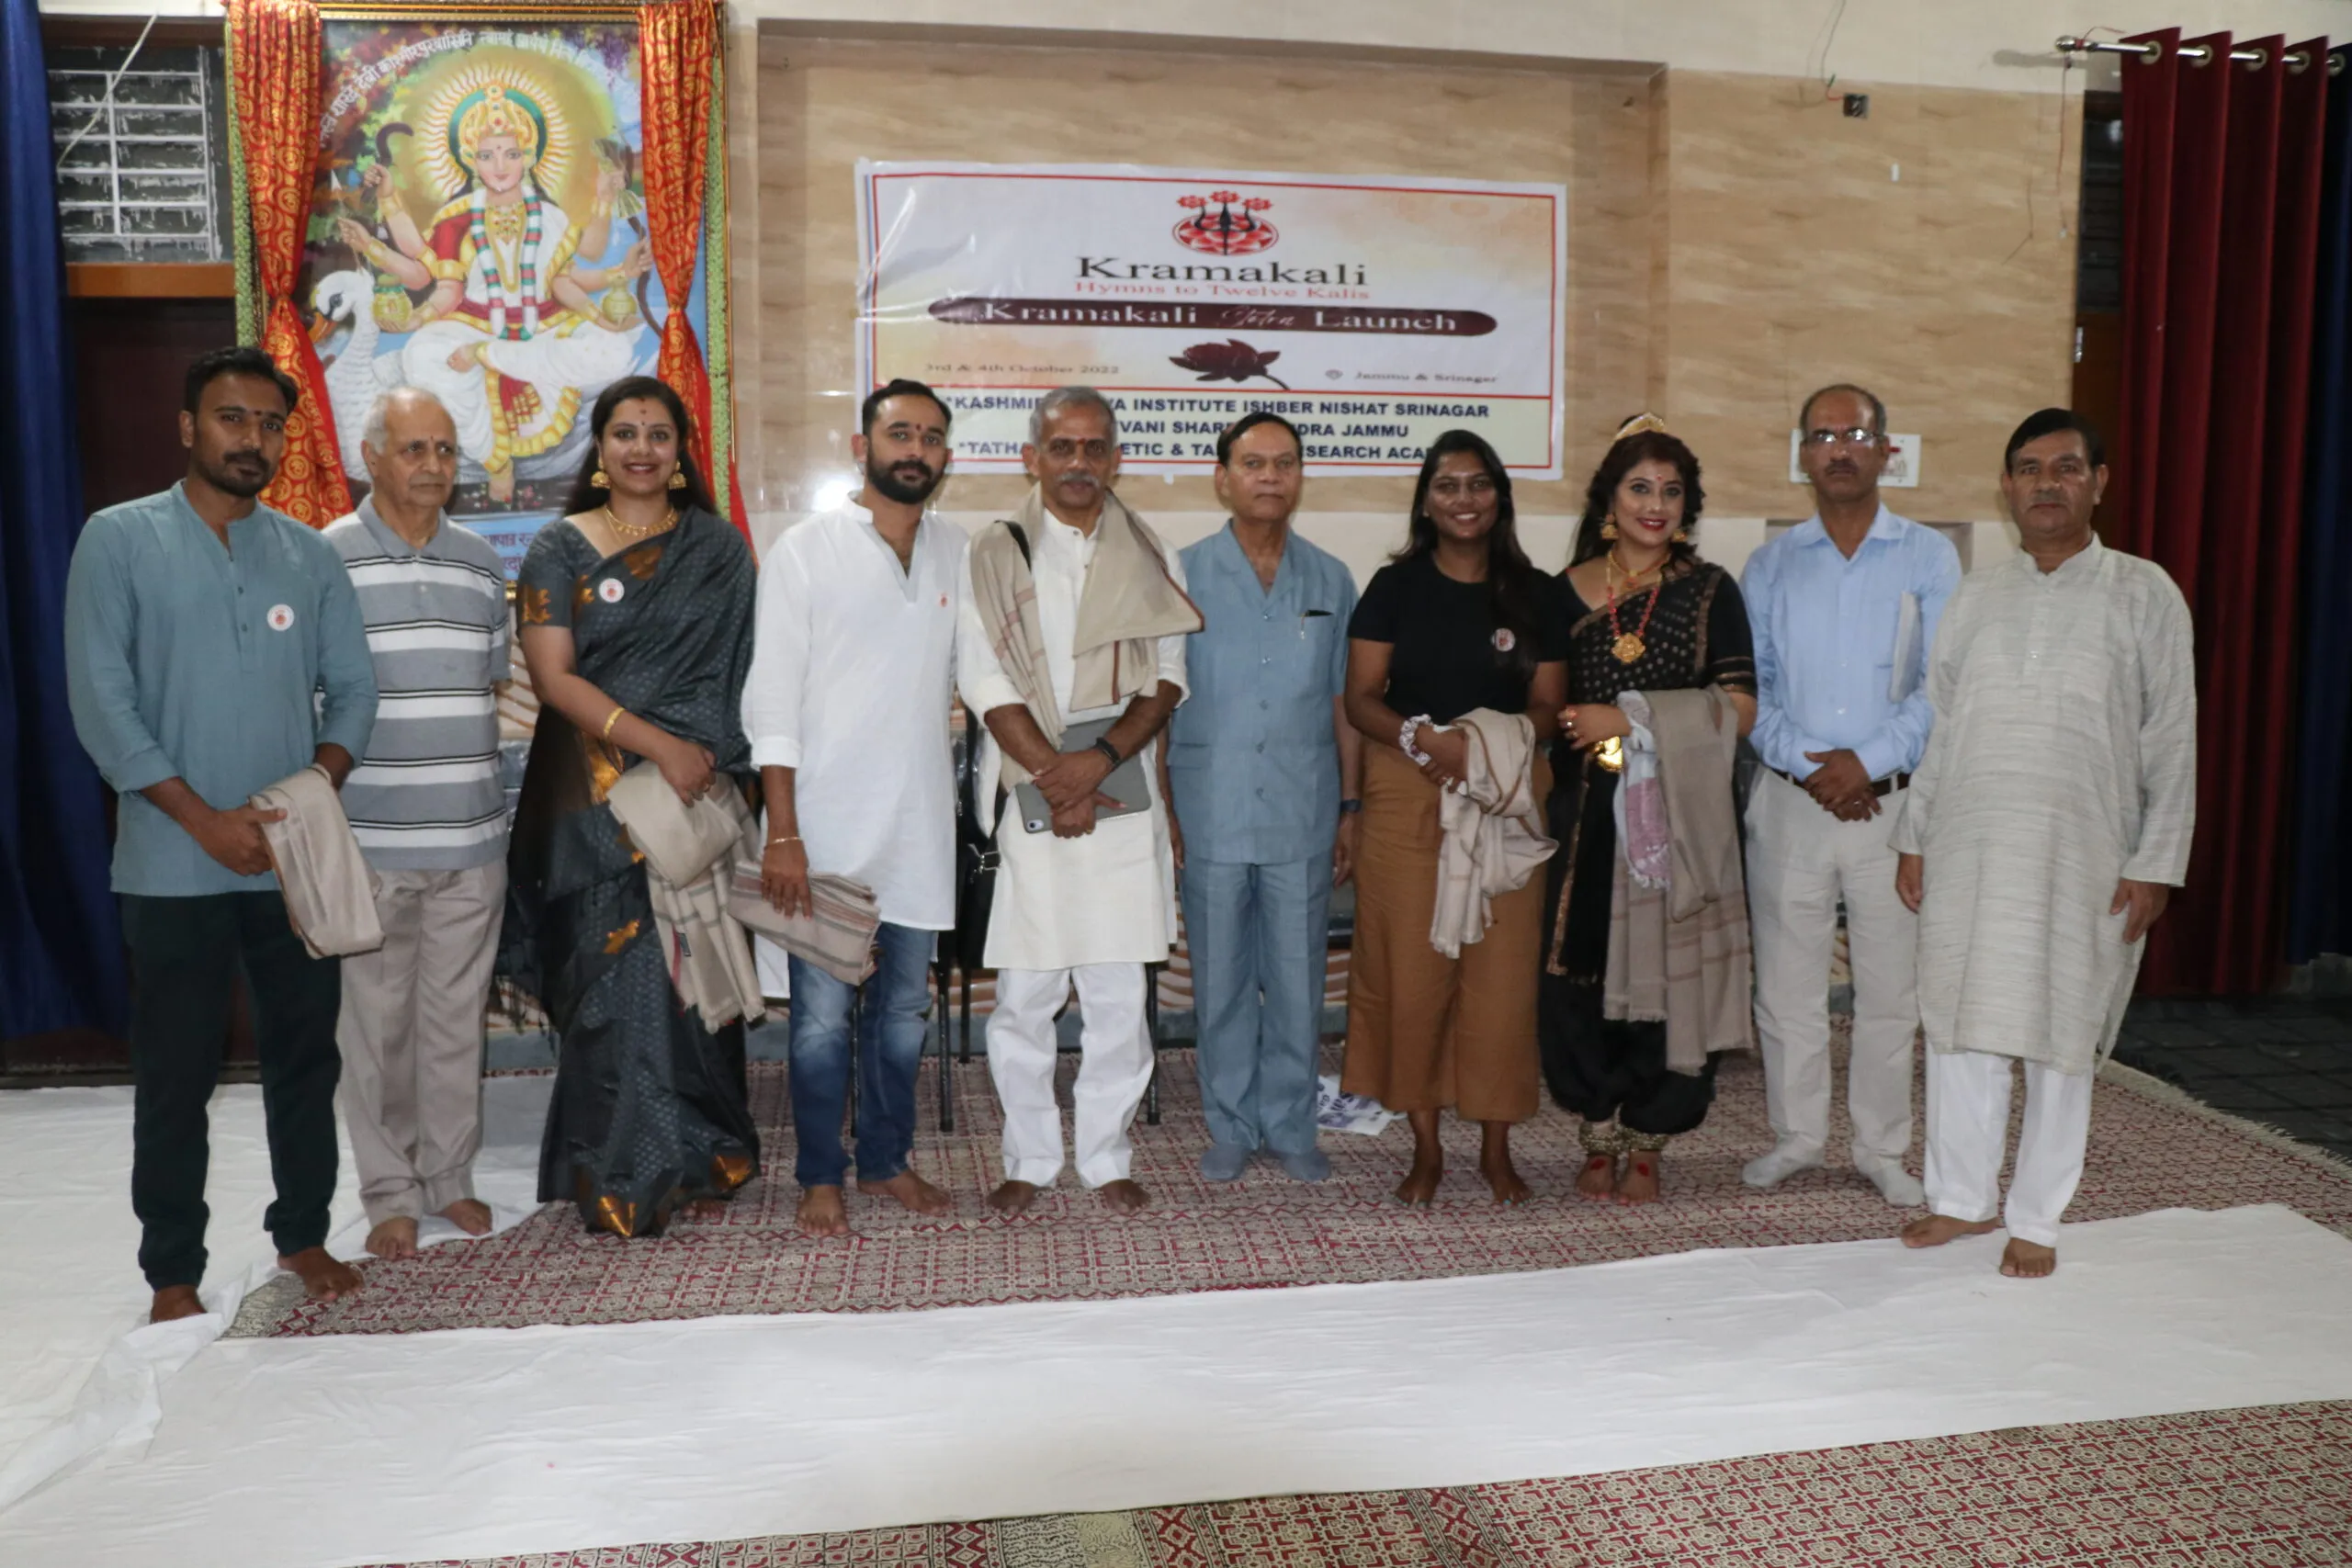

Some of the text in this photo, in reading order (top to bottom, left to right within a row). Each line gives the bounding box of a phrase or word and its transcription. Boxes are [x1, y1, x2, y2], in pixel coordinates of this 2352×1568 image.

[1075, 256, 1370, 286] Kramakali
[1075, 280, 1370, 299] Hymns to Twelve Kalis
[983, 302, 1198, 323] Kramakali
[1315, 310, 1457, 332] Launch
[978, 363, 1004, 372] 4th
[1009, 364, 1073, 374] October
[1080, 365, 1120, 375] 2022
[1355, 371, 1409, 380] Jammu
[1415, 372, 1429, 381] &
[1134, 398, 1238, 412] INSTITUTE
[1243, 400, 1314, 413] ISHBER
[1320, 401, 1390, 415] NISHAT
[1395, 402, 1490, 417] SRINAGAR
[1172, 421, 1228, 434] SHAR
[1341, 423, 1409, 437] JAMMU
[1170, 443, 1183, 457] &
[1302, 445, 1381, 458] SEARCH
